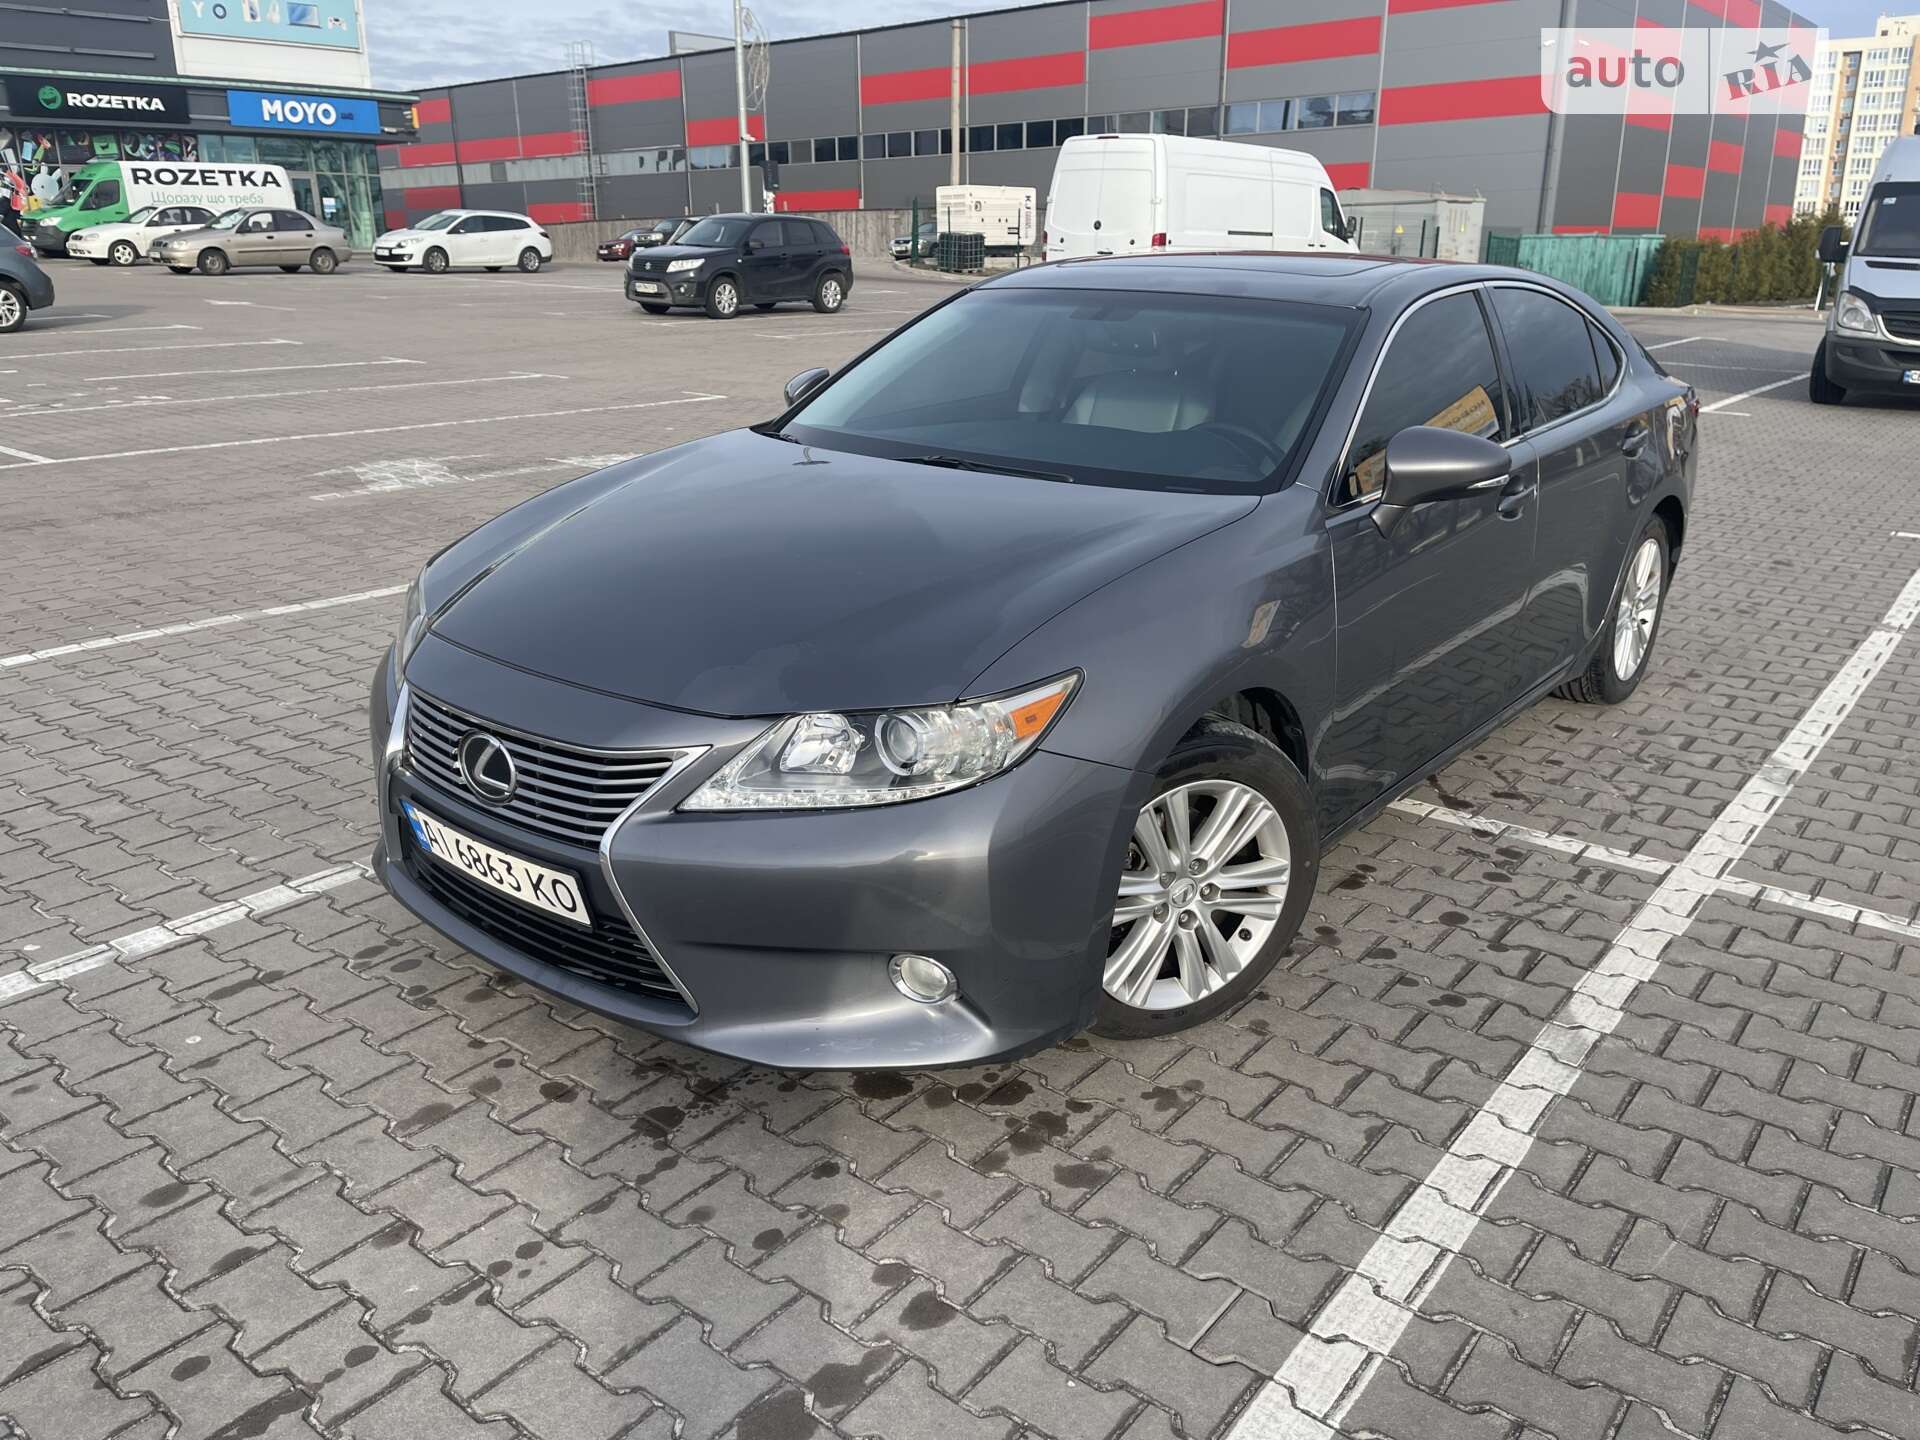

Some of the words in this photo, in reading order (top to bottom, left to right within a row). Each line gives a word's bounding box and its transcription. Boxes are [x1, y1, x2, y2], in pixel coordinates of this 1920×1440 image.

[66, 92, 166, 111] ROZETKA
[261, 98, 337, 126] MOYO
[130, 167, 282, 188] ROZETKA
[150, 191, 202, 206] Щоразу
[206, 194, 226, 204] що
[229, 193, 264, 206] треба
[423, 819, 453, 859] AI
[455, 838, 522, 892] 6863
[525, 867, 577, 913] KO
